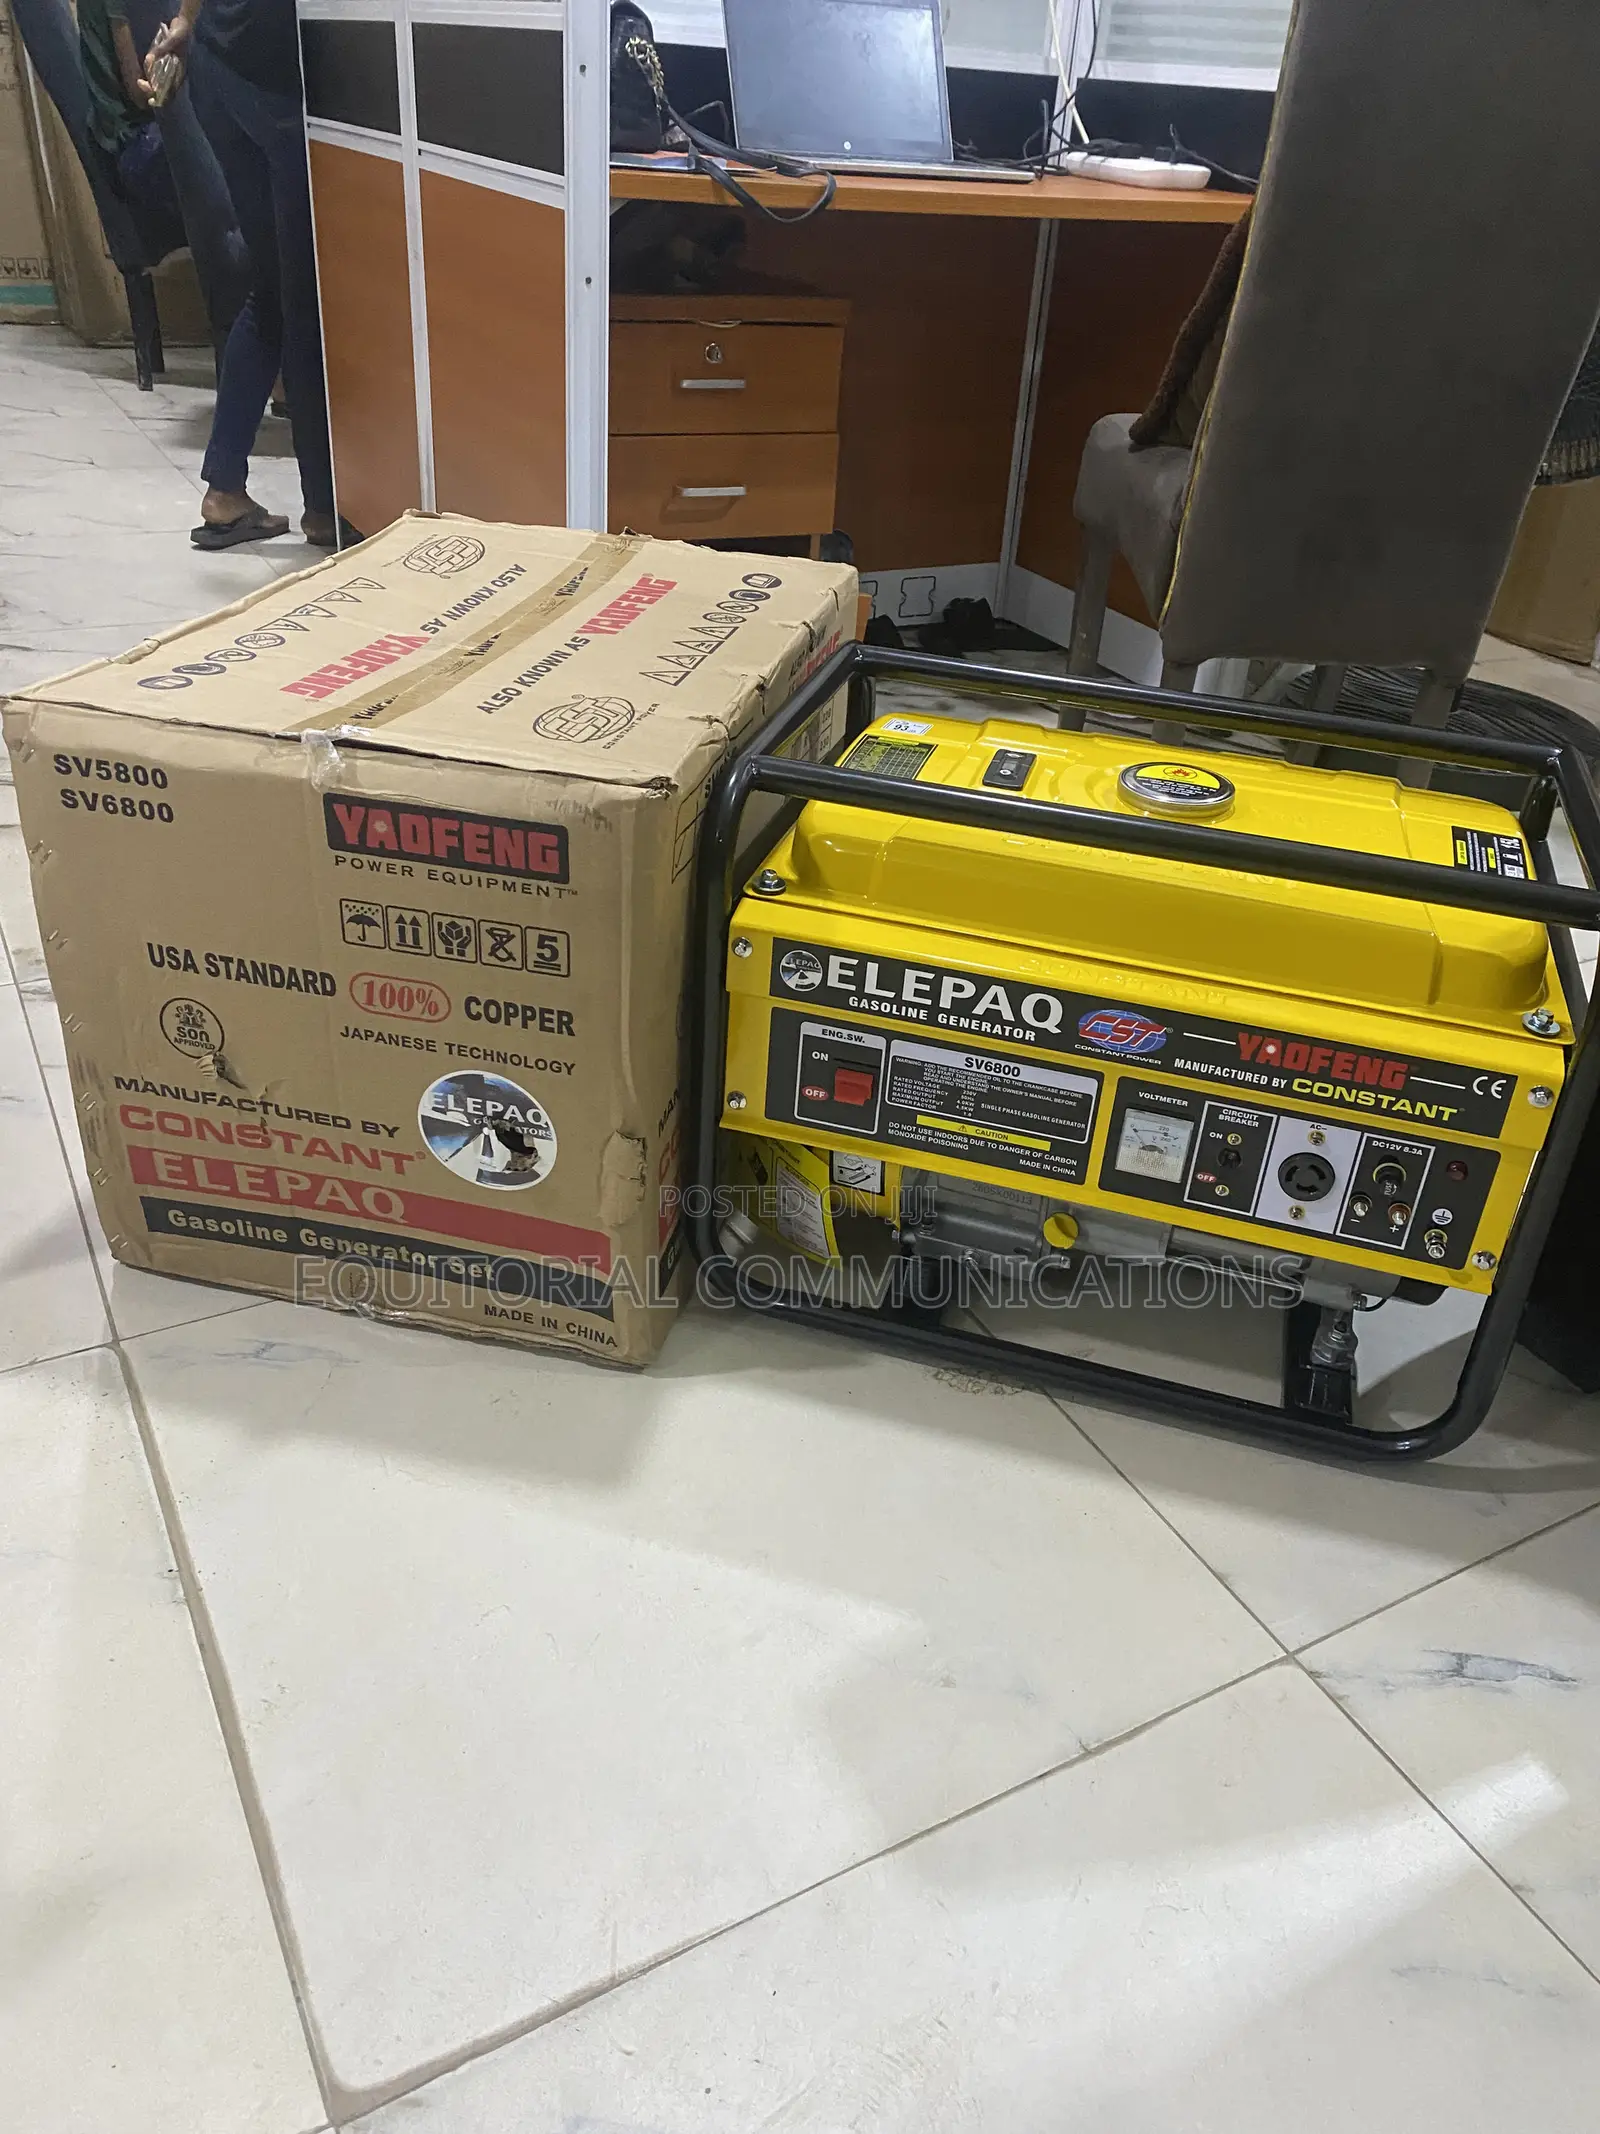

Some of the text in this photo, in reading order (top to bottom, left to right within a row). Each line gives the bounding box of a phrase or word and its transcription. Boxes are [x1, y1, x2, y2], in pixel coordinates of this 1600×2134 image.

[419, 563, 527, 635] ALSO KNOWN AS
[576, 575, 678, 635] YAOFENG
[280, 634, 432, 699] YAOFENG
[476, 636, 591, 715] ALSO KNOWN AS
[54, 754, 168, 789] SV5800
[60, 788, 174, 823] SV6800
[333, 803, 560, 875] YAOFENG
[334, 855, 414, 878] POWER
[536, 933, 559, 962] 5
[147, 942, 337, 997] USA STANDARD
[361, 979, 440, 1016] 100%
[826, 954, 1064, 1034] ELEPAQ
[463, 995, 575, 1036] COPPER
[849, 996, 1037, 1042] GASOLINE GENERATOR
[174, 1037, 216, 1051] APPROVED
[821, 1028, 866, 1044] ENG.SW.
[1079, 1014, 1168, 1048] CST
[340, 1025, 576, 1076] JAPANESE TECHNOLOGY
[811, 1051, 829, 1062] ON
[1074, 1043, 1162, 1065] CONSTANT POWER
[1237, 1031, 1409, 1091] YAOFENG
[924, 1067, 936, 1075] YOU
[964, 1056, 1021, 1078] SV6800
[804, 1088, 826, 1099] OFF
[892, 1086, 936, 1099] RATED OUTPUT
[893, 1075, 940, 1090] RATED VOLTAGE
[893, 1081, 948, 1096] RATED FREQUENCY
[923, 1076, 955, 1087] OPERATING
[924, 1071, 939, 1079] READ
[953, 1076, 989, 1089] UNDERSTAND
[1029, 1092, 1053, 1102] MANUAL
[1053, 1097, 1077, 1107] BEFORE
[949, 1067, 992, 1080] RECOMMENDED
[1023, 1083, 1059, 1094] CRANKCASE
[1174, 1058, 1458, 1122] MANUFACTURED BY CONSTANT
[1472, 1075, 1507, 1099] CE
[114, 1076, 400, 1139] MANUFACTURED BY
[891, 1097, 937, 1110] POWER FACTOR
[892, 1091, 944, 1106] MAXIMUM OUTPUT
[1138, 1091, 1189, 1107] VOLTMETER
[981, 1103, 1086, 1129] SINGLE PHASE GASOLINE GENERATOR
[1218, 1114, 1260, 1128] BREAKER
[1222, 1108, 1259, 1121] CIRCUIT
[119, 1104, 414, 1175] CONSTANT
[887, 1128, 969, 1150] MONOXIDE POISONING
[888, 1121, 900, 1129] DO
[901, 1124, 916, 1132] NOT
[918, 1127, 933, 1136] USE
[934, 1131, 968, 1143] INDOORS
[969, 1138, 985, 1147] DUE
[998, 1144, 1031, 1157] DANGER
[1032, 1151, 1043, 1159] OF
[1044, 1153, 1078, 1166] CARBON
[975, 1128, 1009, 1140] CAUTION
[1209, 1131, 1223, 1140] ON
[1372, 1140, 1423, 1156] DC12V 8.3A
[1019, 1159, 1041, 1169] MADE
[1052, 1166, 1077, 1177] CHINA
[1197, 1173, 1215, 1182] OFF
[151, 1151, 409, 1225] ELEPAQ
[168, 1209, 495, 1281] Gasoline Generator Set
[484, 1304, 618, 1348] MADE IN CHINA
